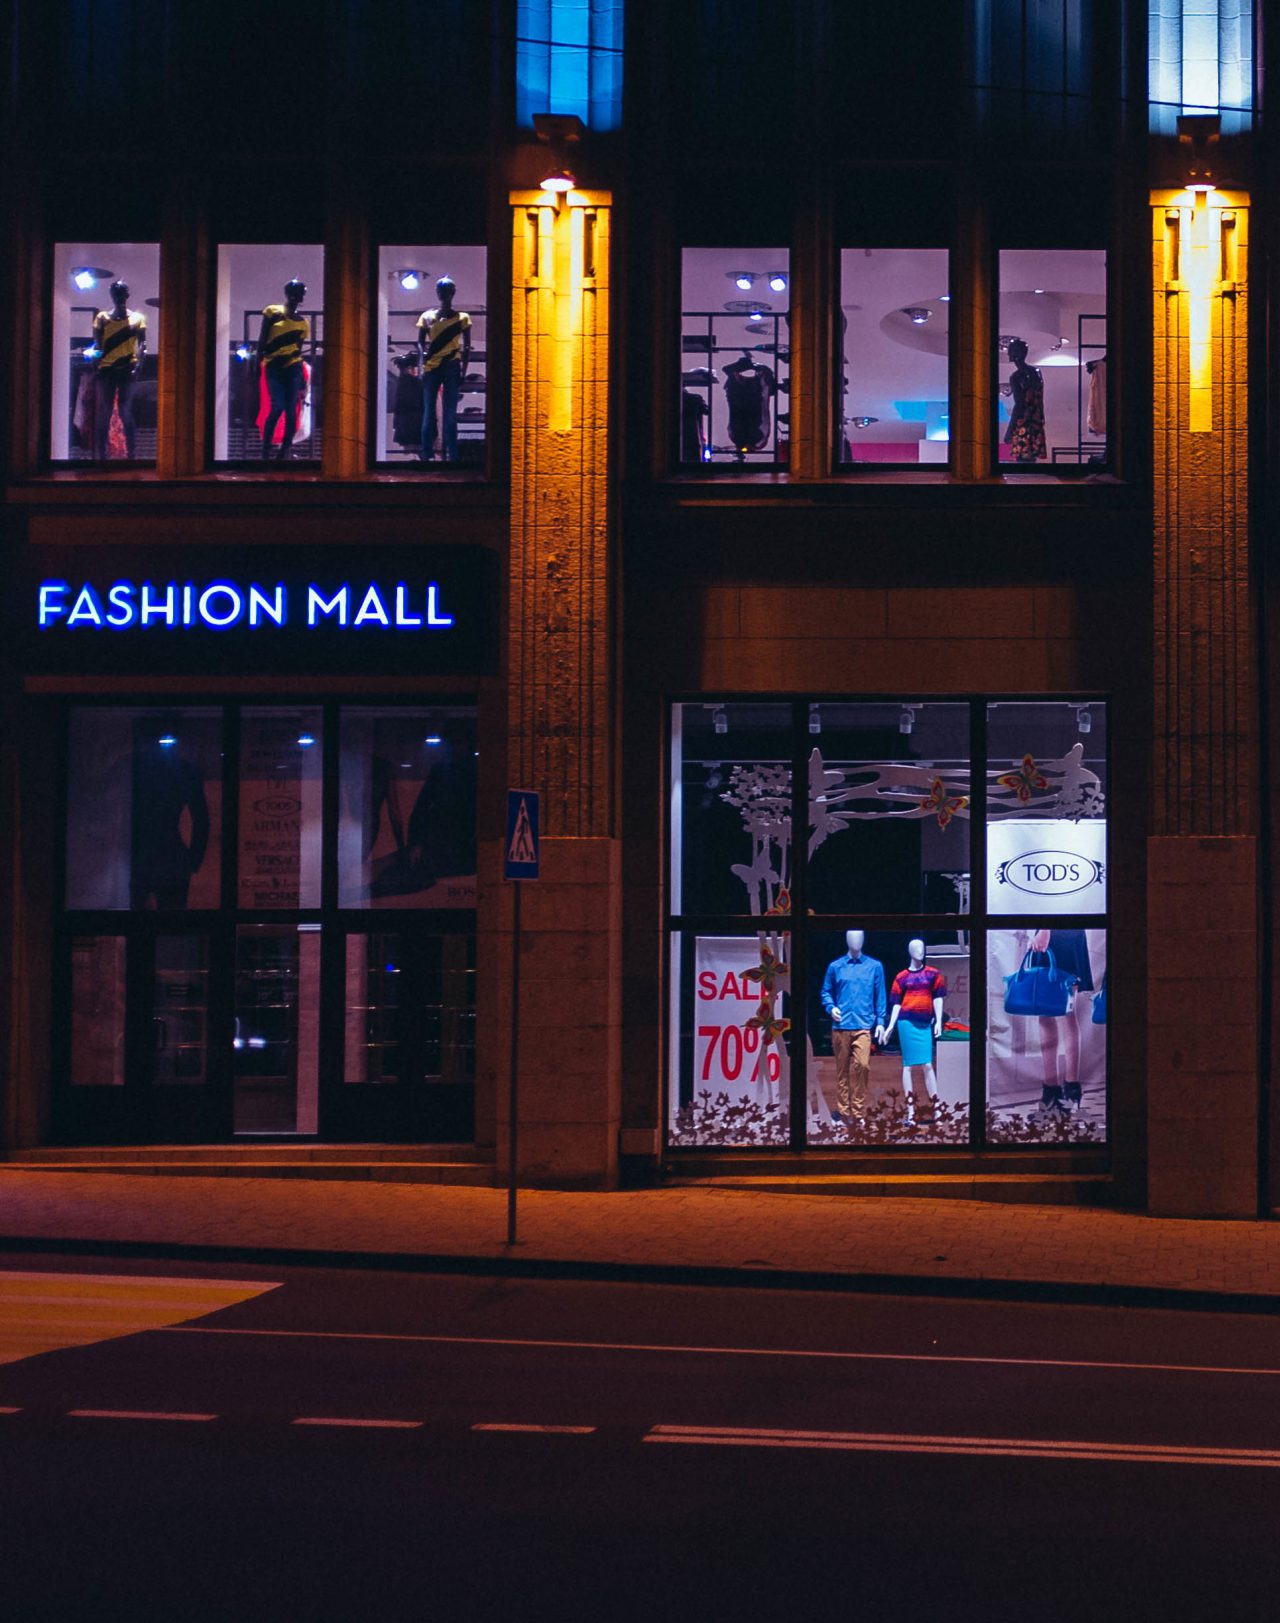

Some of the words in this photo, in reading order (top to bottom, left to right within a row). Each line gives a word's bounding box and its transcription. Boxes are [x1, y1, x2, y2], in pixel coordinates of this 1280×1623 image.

[37, 582, 284, 626] FASHION
[306, 583, 453, 626] MALL
[1022, 863, 1080, 882] TOD'S
[944, 975, 968, 994] LE
[698, 1025, 780, 1082] 70%
